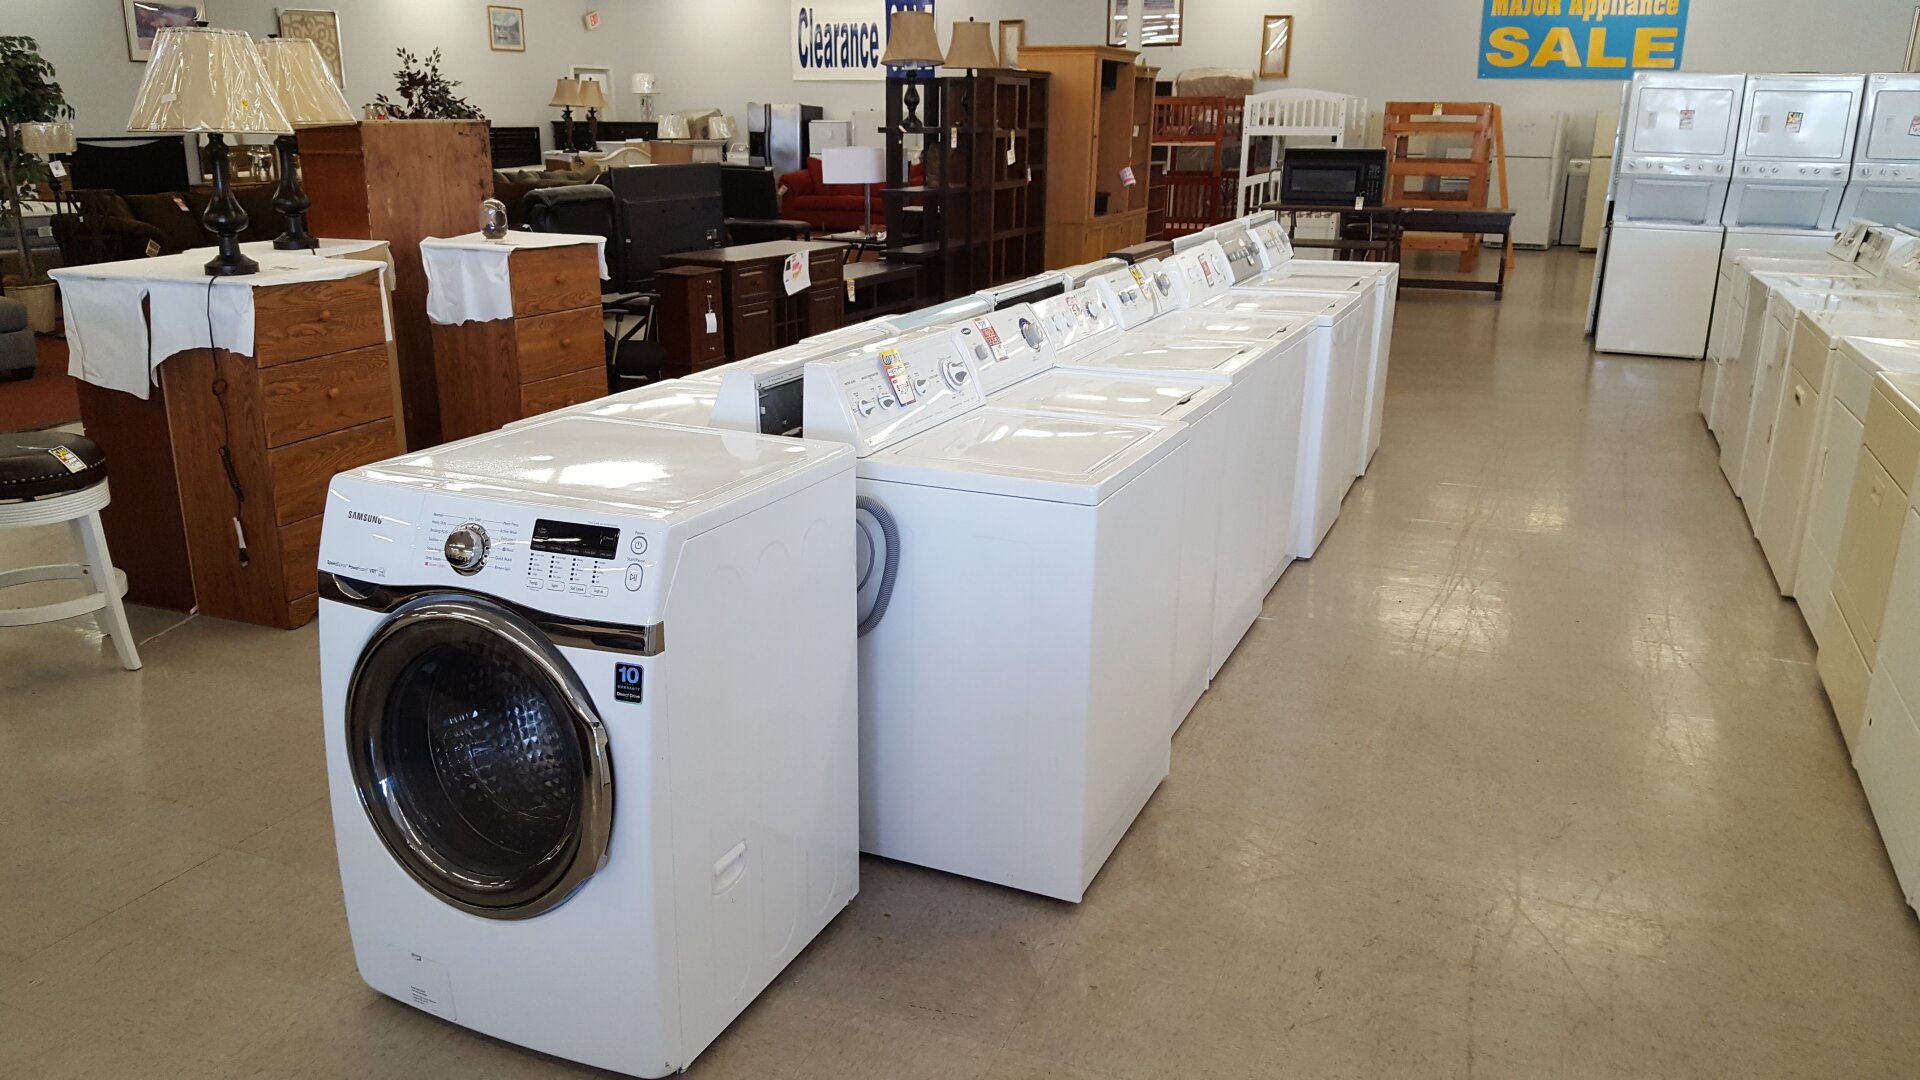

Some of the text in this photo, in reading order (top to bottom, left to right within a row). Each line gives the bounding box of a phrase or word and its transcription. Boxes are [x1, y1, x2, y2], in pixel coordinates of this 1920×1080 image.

[1491, 0, 1680, 21] MAJOR Appliance
[798, 7, 879, 69] Clearance
[1486, 26, 1678, 68] SALE
[348, 510, 382, 524] SAMSUNG
[618, 666, 639, 683] 10
